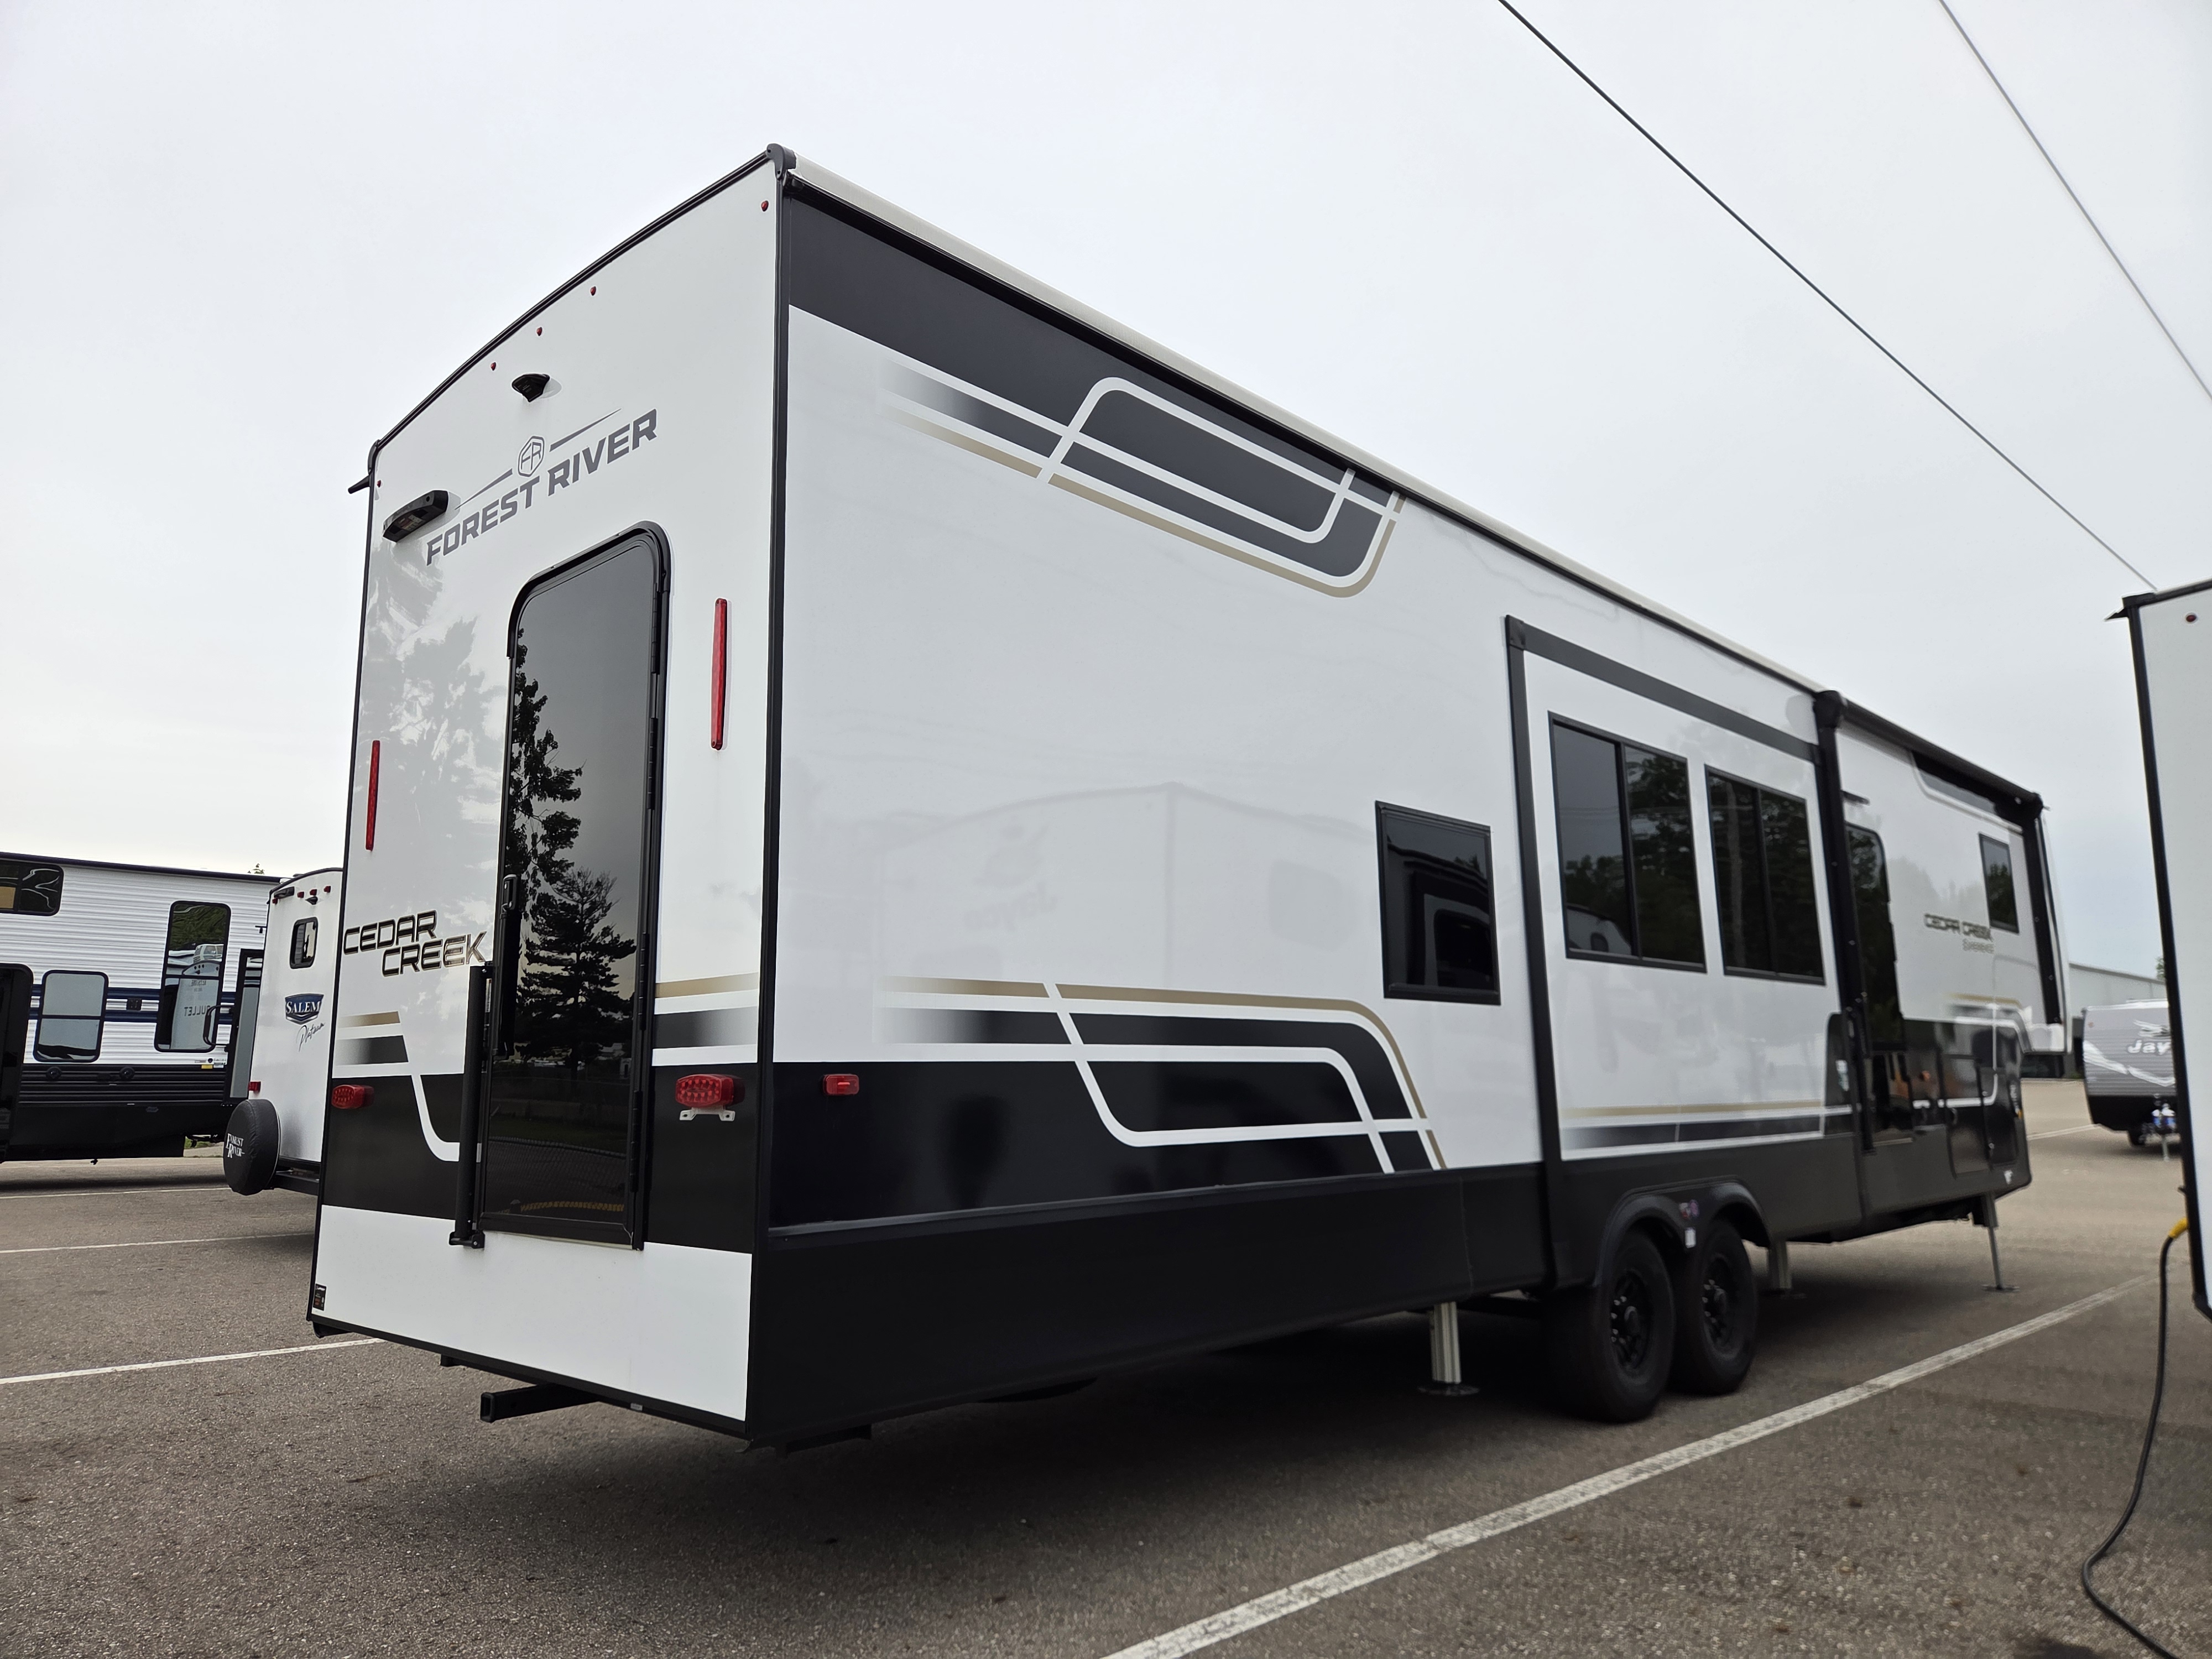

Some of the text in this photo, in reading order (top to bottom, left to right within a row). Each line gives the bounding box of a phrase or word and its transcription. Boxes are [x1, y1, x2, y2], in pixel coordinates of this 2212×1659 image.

[426, 408, 658, 566] FOREST RIVER
[343, 910, 437, 955] CEDAR
[382, 931, 487, 977] CREEK
[286, 1001, 321, 1014] SALEM
